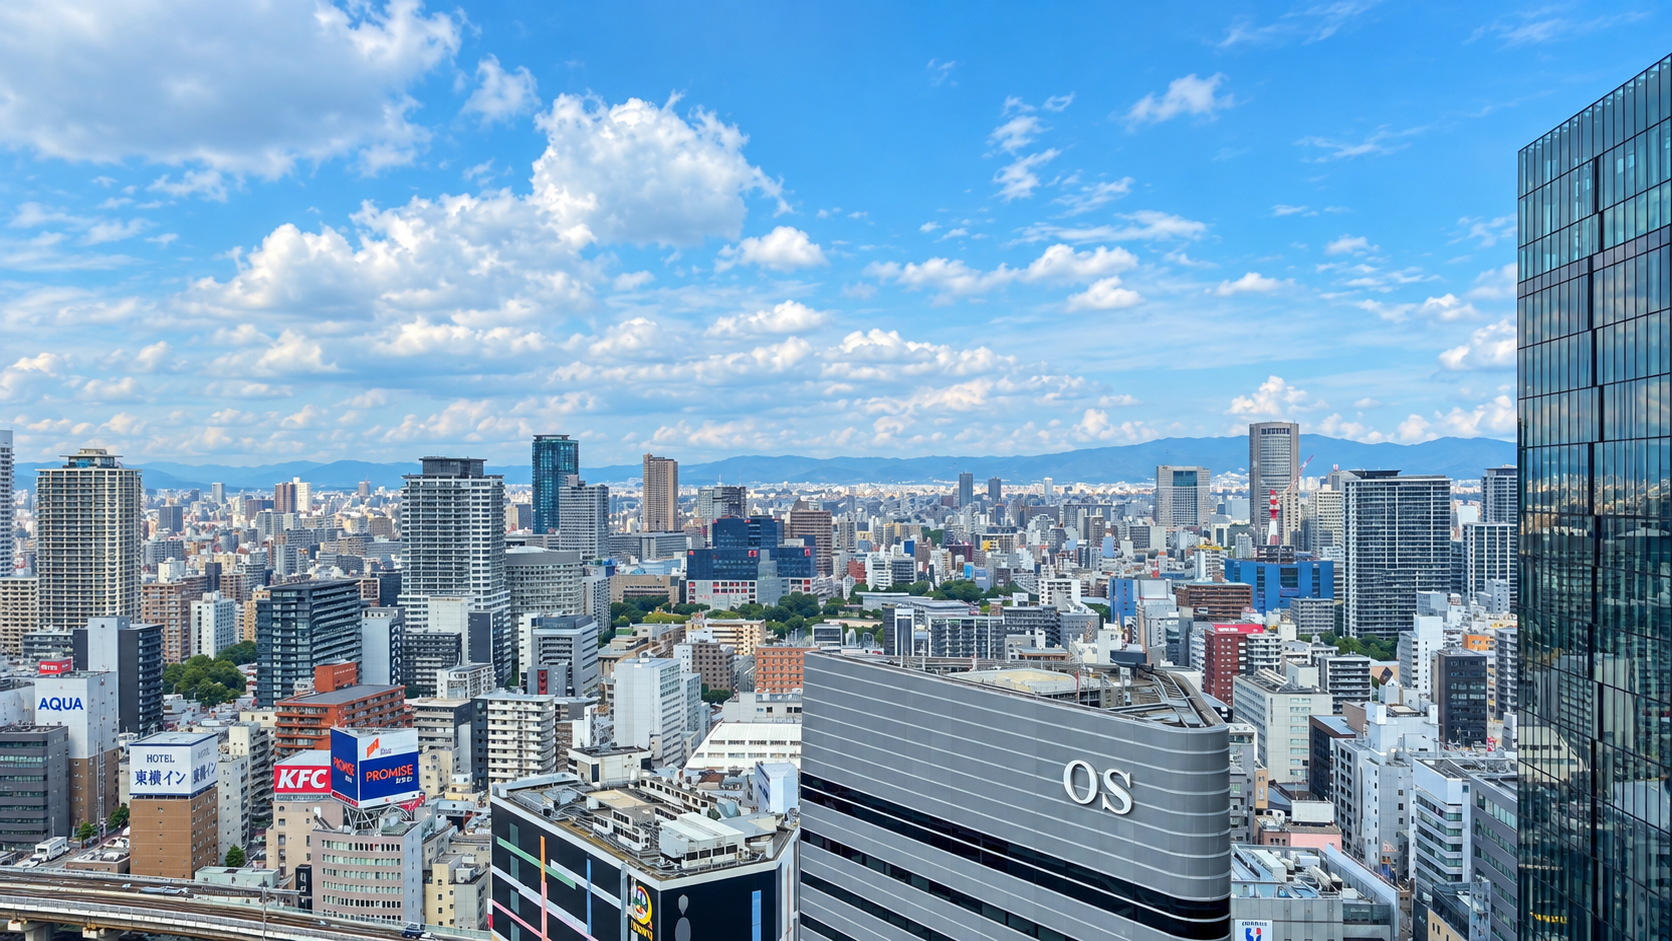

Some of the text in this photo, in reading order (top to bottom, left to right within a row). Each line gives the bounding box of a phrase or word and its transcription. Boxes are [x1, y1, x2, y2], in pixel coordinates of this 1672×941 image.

[38, 697, 84, 711] AQUA
[146, 754, 175, 763] HOTEL
[135, 769, 186, 786] 東横イン
[277, 769, 328, 789] KFC
[366, 764, 413, 782] PROMISE
[1063, 760, 1133, 815] OS
